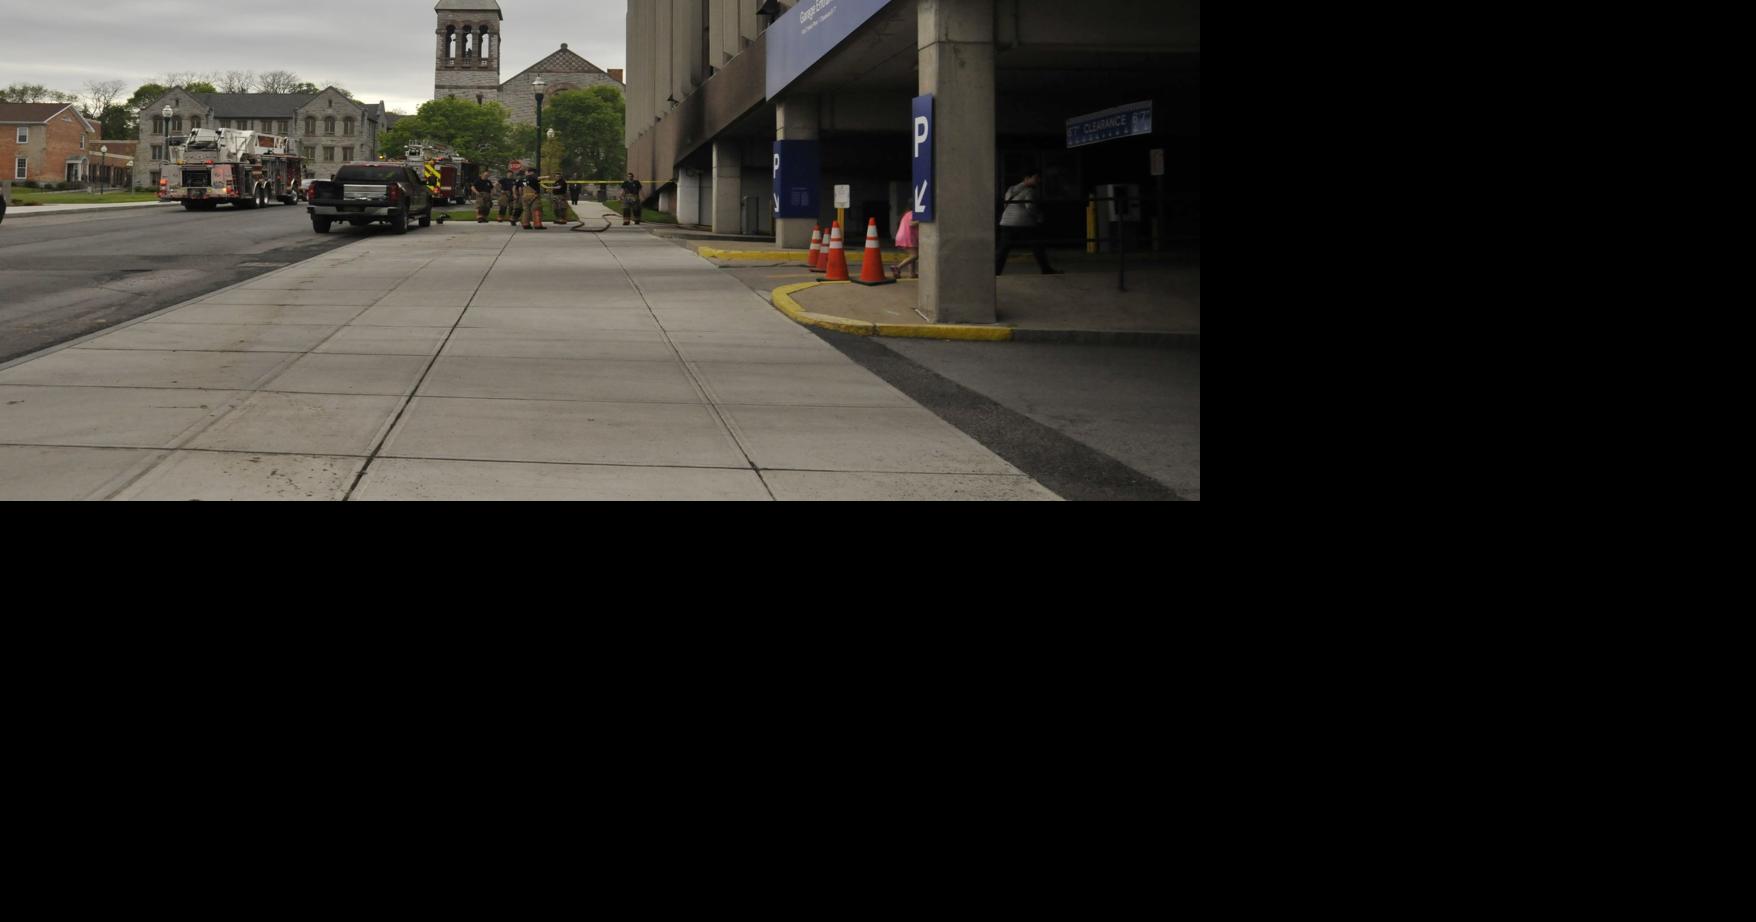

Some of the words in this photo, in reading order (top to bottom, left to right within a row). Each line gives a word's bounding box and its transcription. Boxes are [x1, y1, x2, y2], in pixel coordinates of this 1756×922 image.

[800, 5, 815, 24] Garage
[1083, 114, 1127, 134] CLEARANCE
[914, 116, 928, 158] P
[773, 153, 780, 179] P
